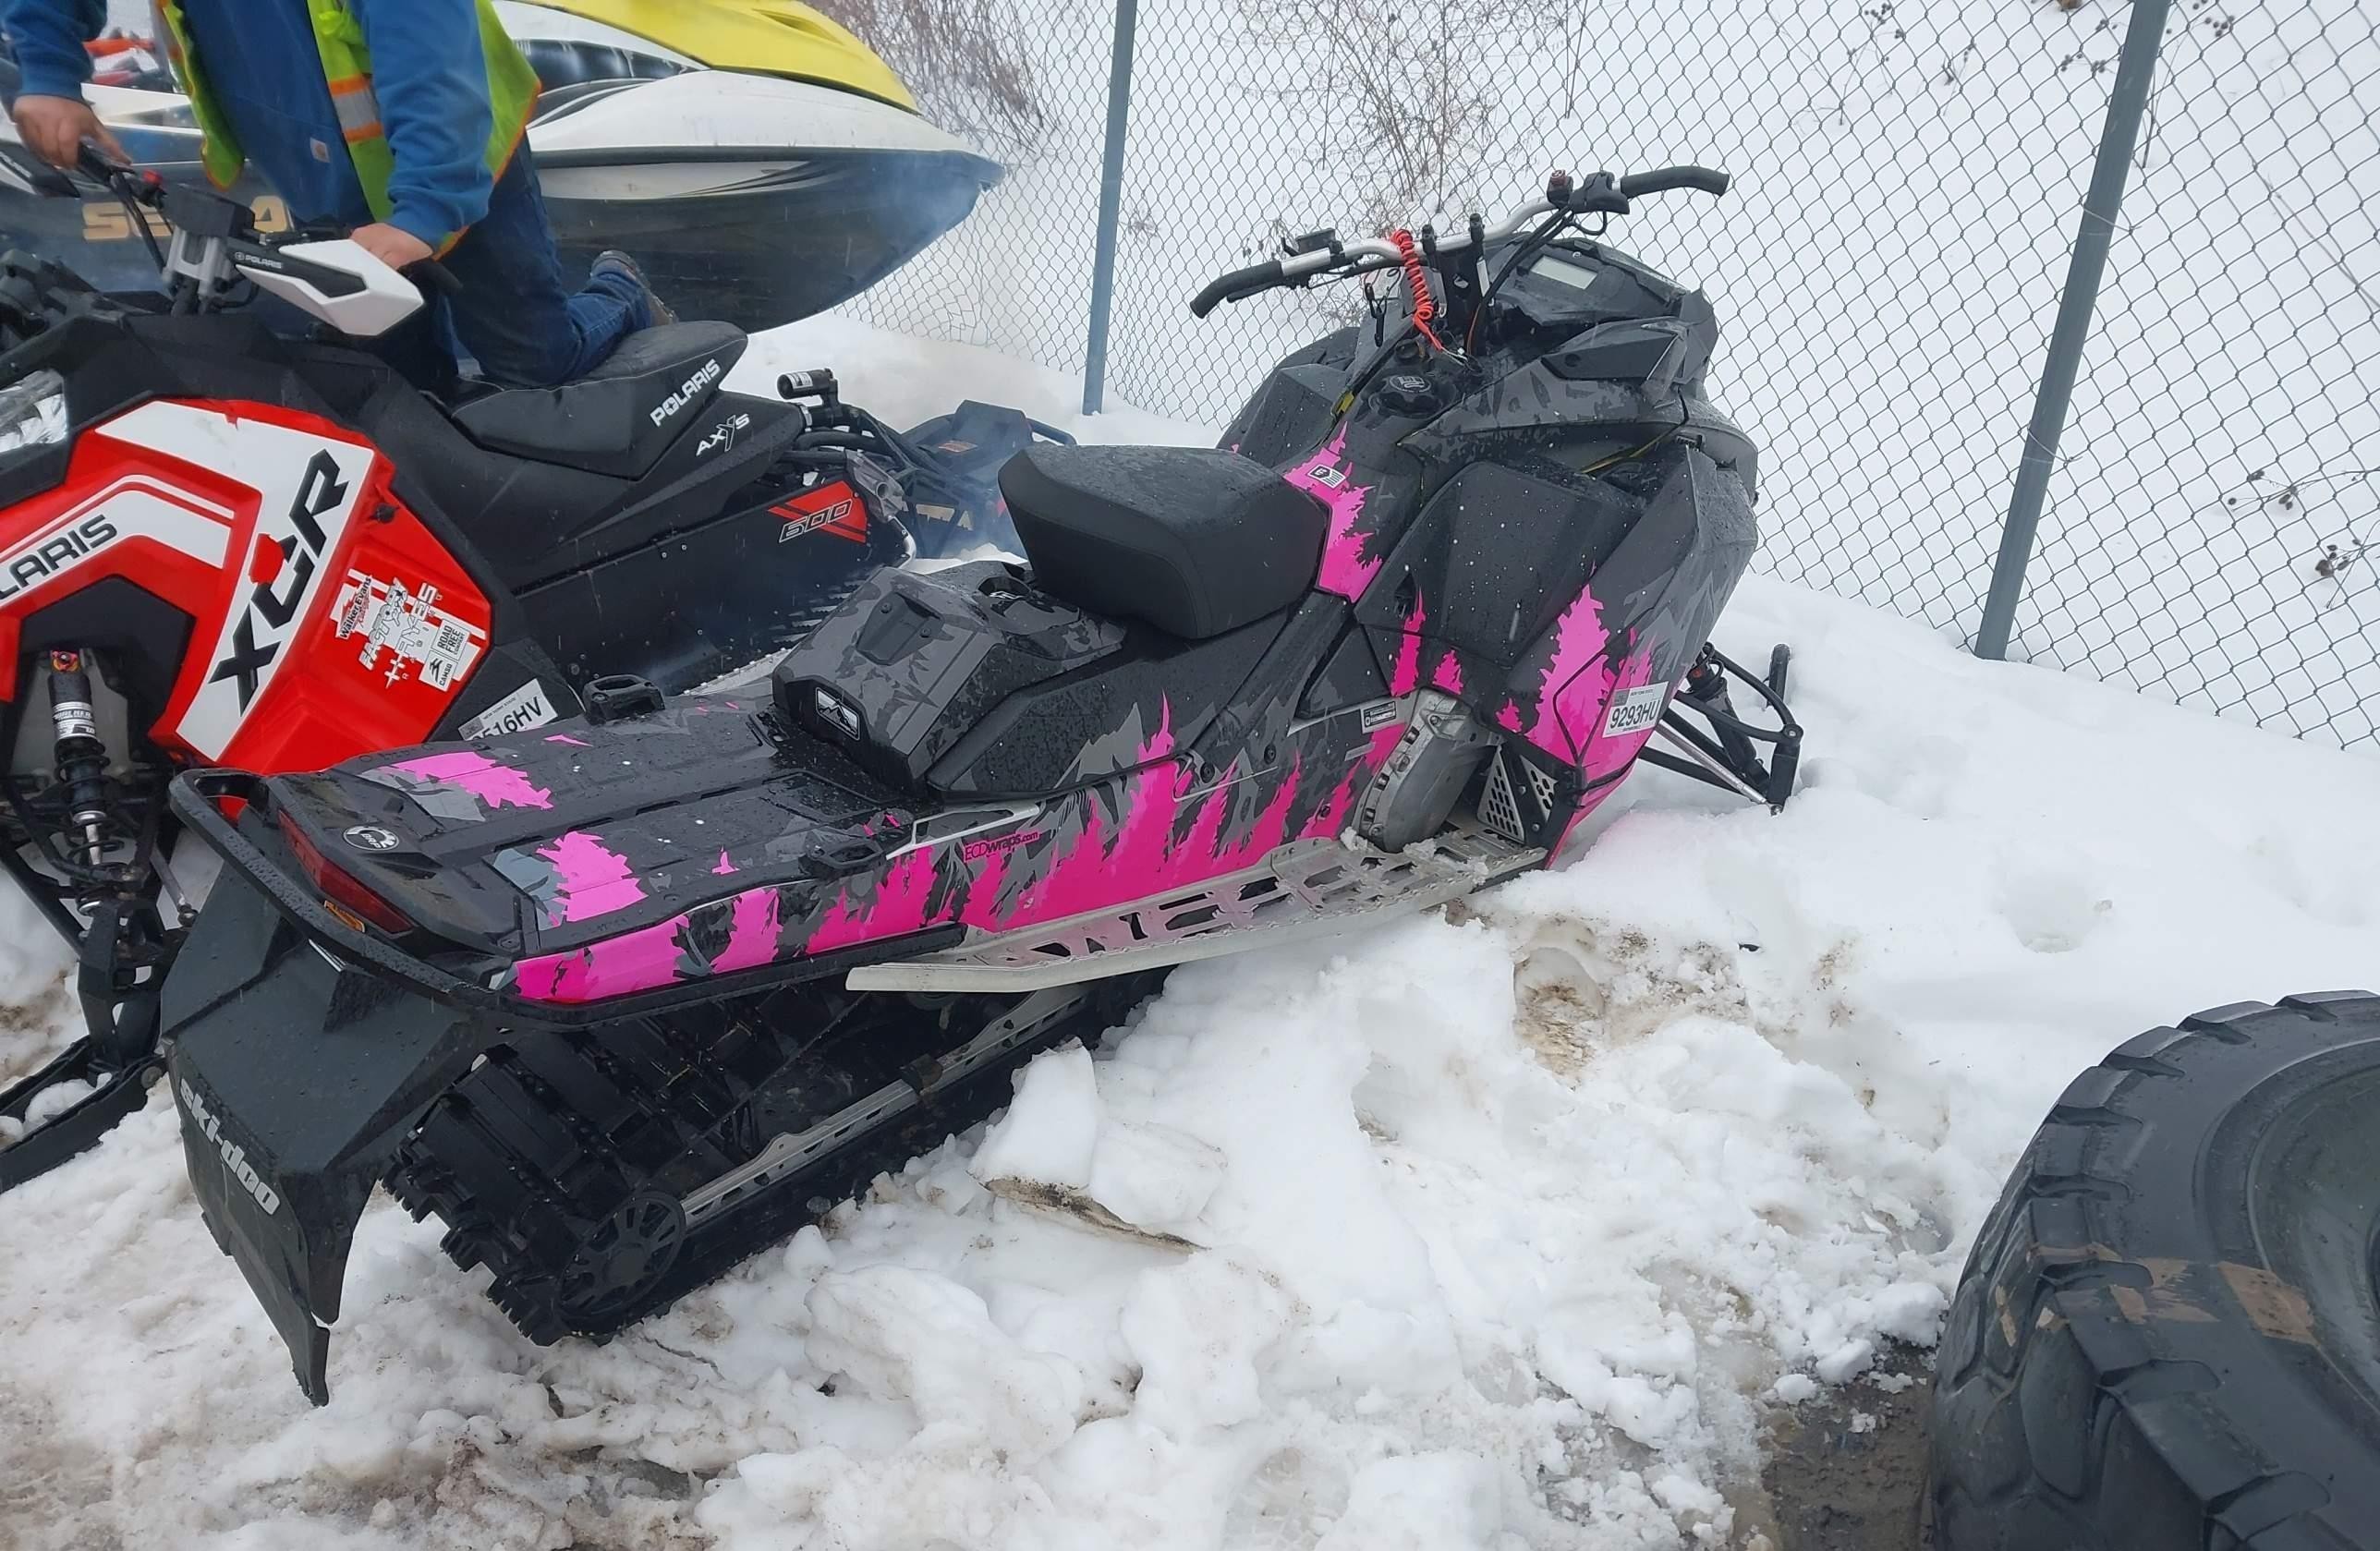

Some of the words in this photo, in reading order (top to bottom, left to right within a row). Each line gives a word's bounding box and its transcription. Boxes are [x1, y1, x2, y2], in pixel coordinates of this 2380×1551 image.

[650, 358, 721, 427] POLARIS
[696, 413, 750, 456] AXYS
[778, 498, 853, 543] 600
[208, 448, 349, 717] XCR
[340, 605, 359, 638] Walker
[358, 576, 372, 607] Evans
[437, 624, 453, 649] ROAD
[445, 629, 461, 653] FREE
[439, 663, 453, 686] CAMSO
[1610, 699, 1660, 729] 9293HU
[180, 1077, 281, 1216] ski-doo
